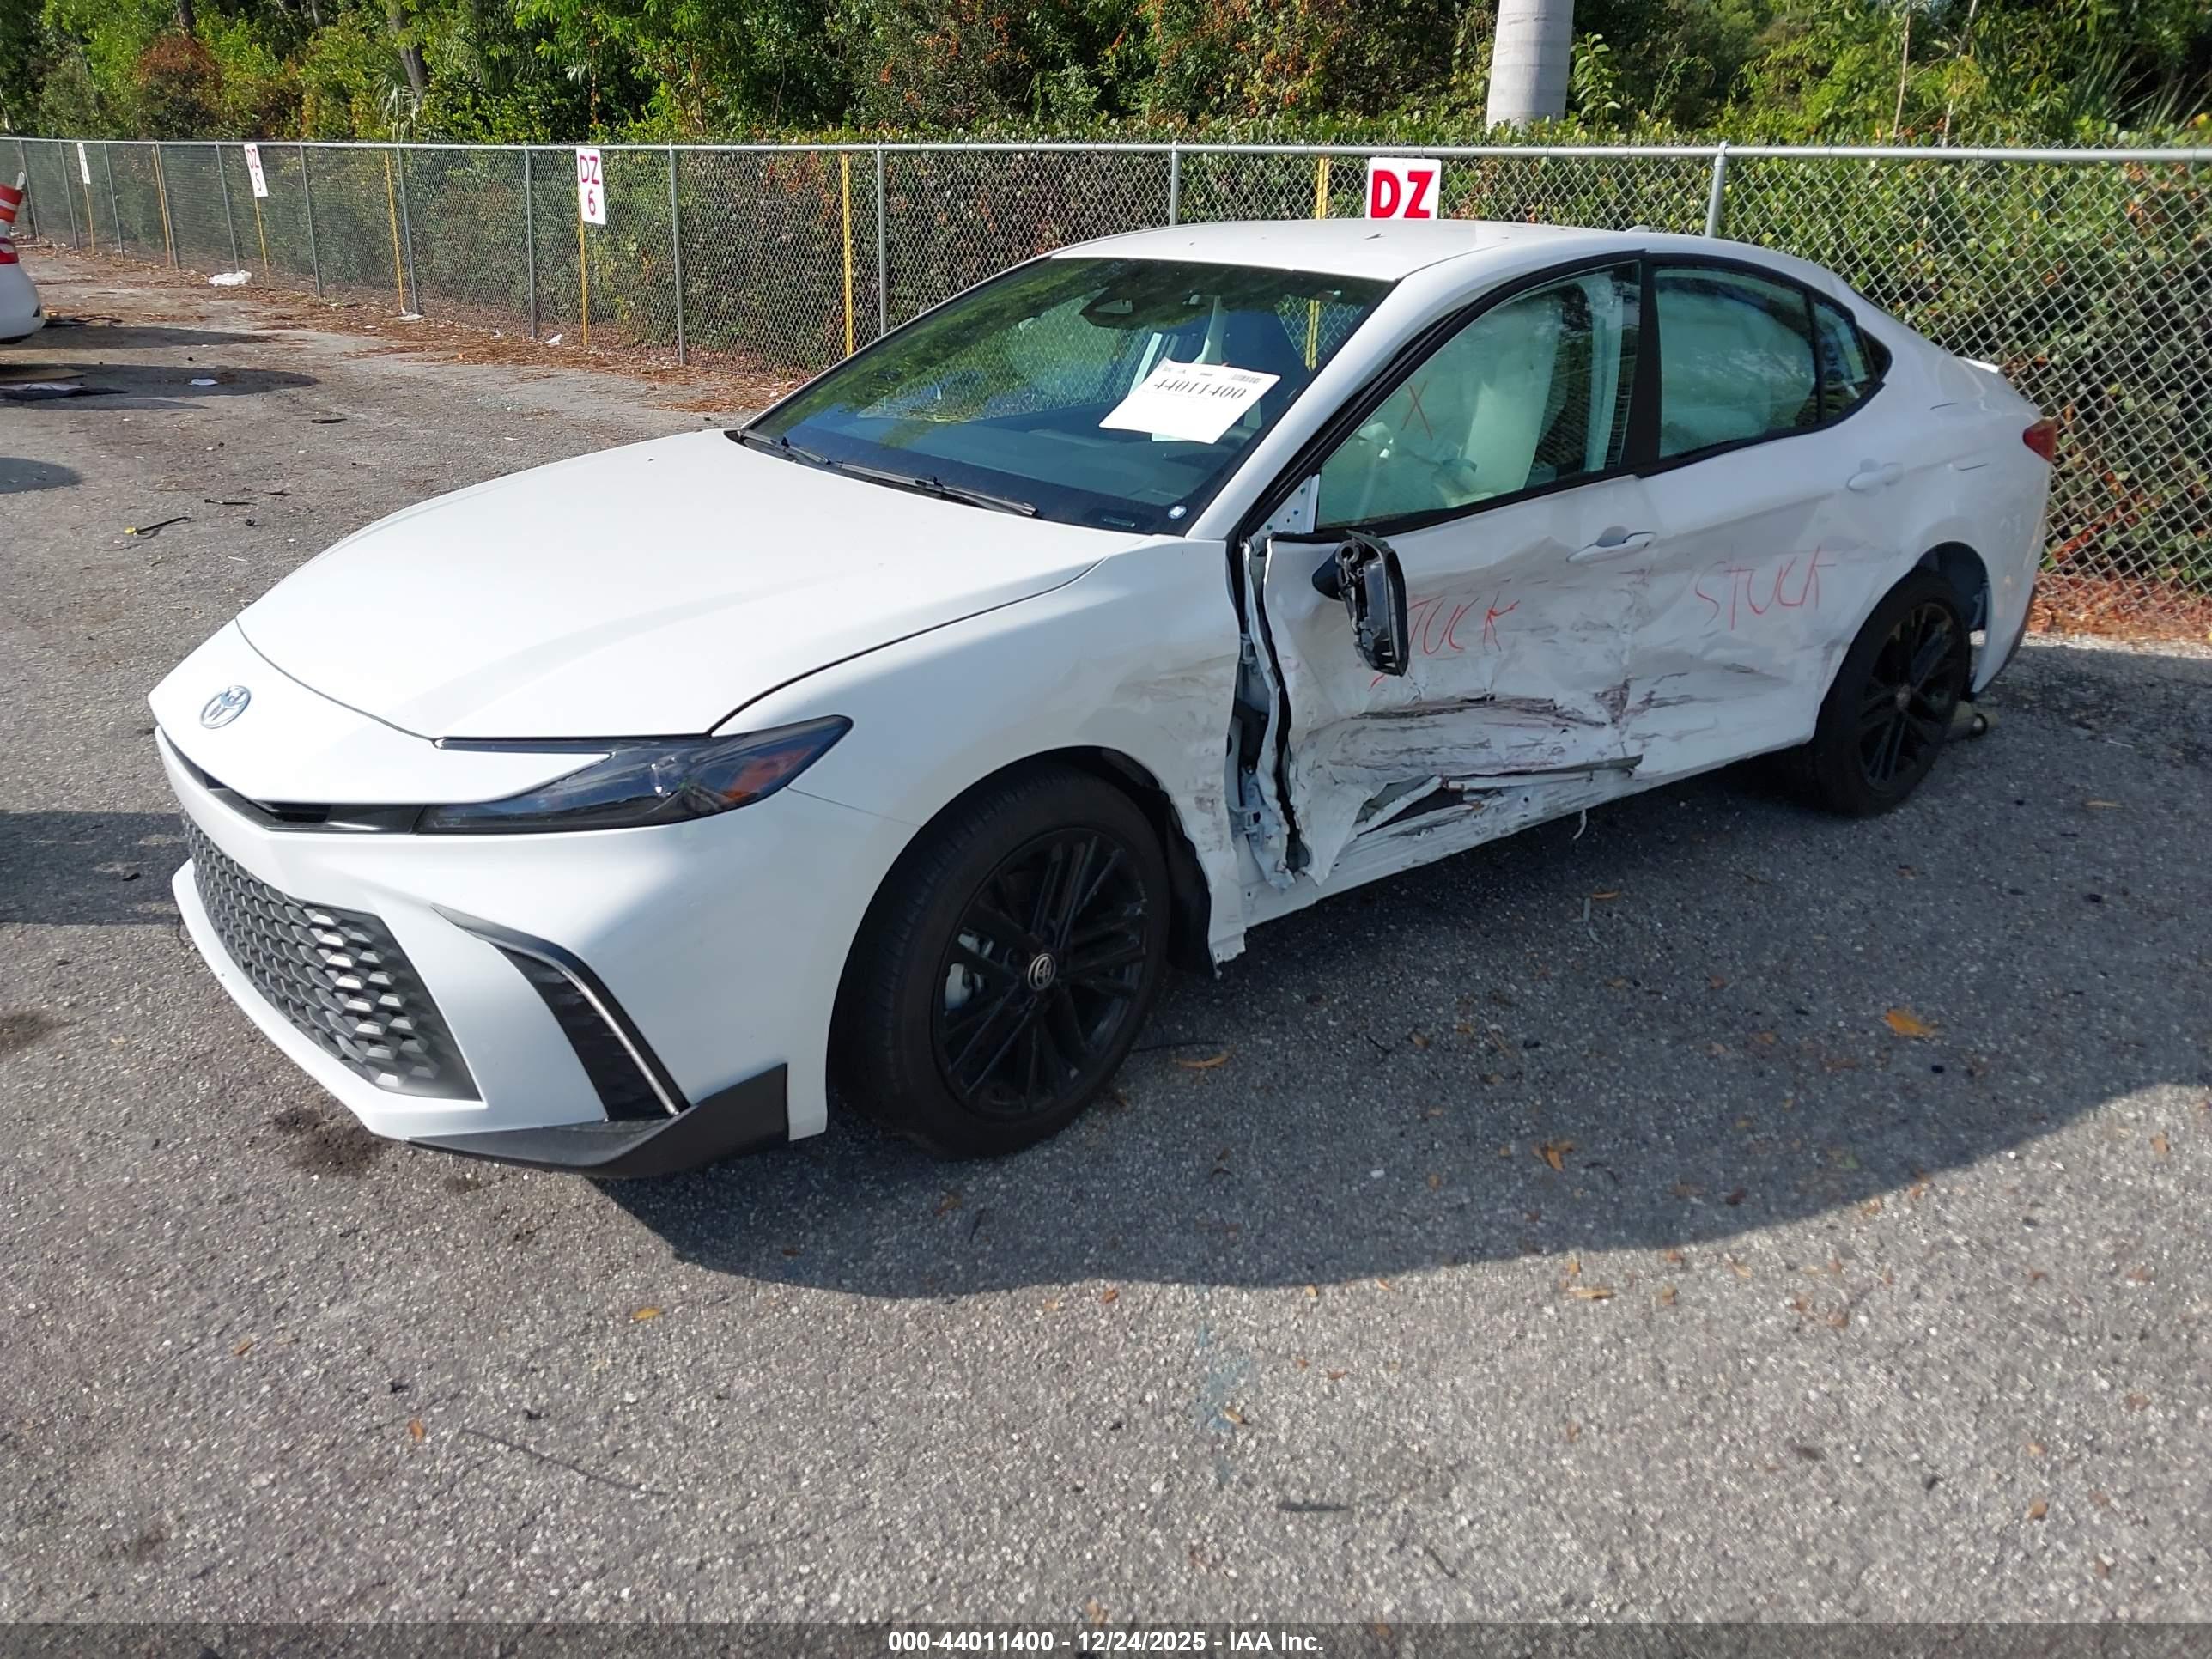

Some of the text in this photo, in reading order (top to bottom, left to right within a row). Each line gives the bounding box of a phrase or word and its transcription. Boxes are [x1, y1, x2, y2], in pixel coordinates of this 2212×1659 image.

[580, 155, 599, 184] DZ
[588, 189, 596, 216] 6
[1370, 170, 1434, 218] DZ
[1154, 378, 1247, 398] 44011400
